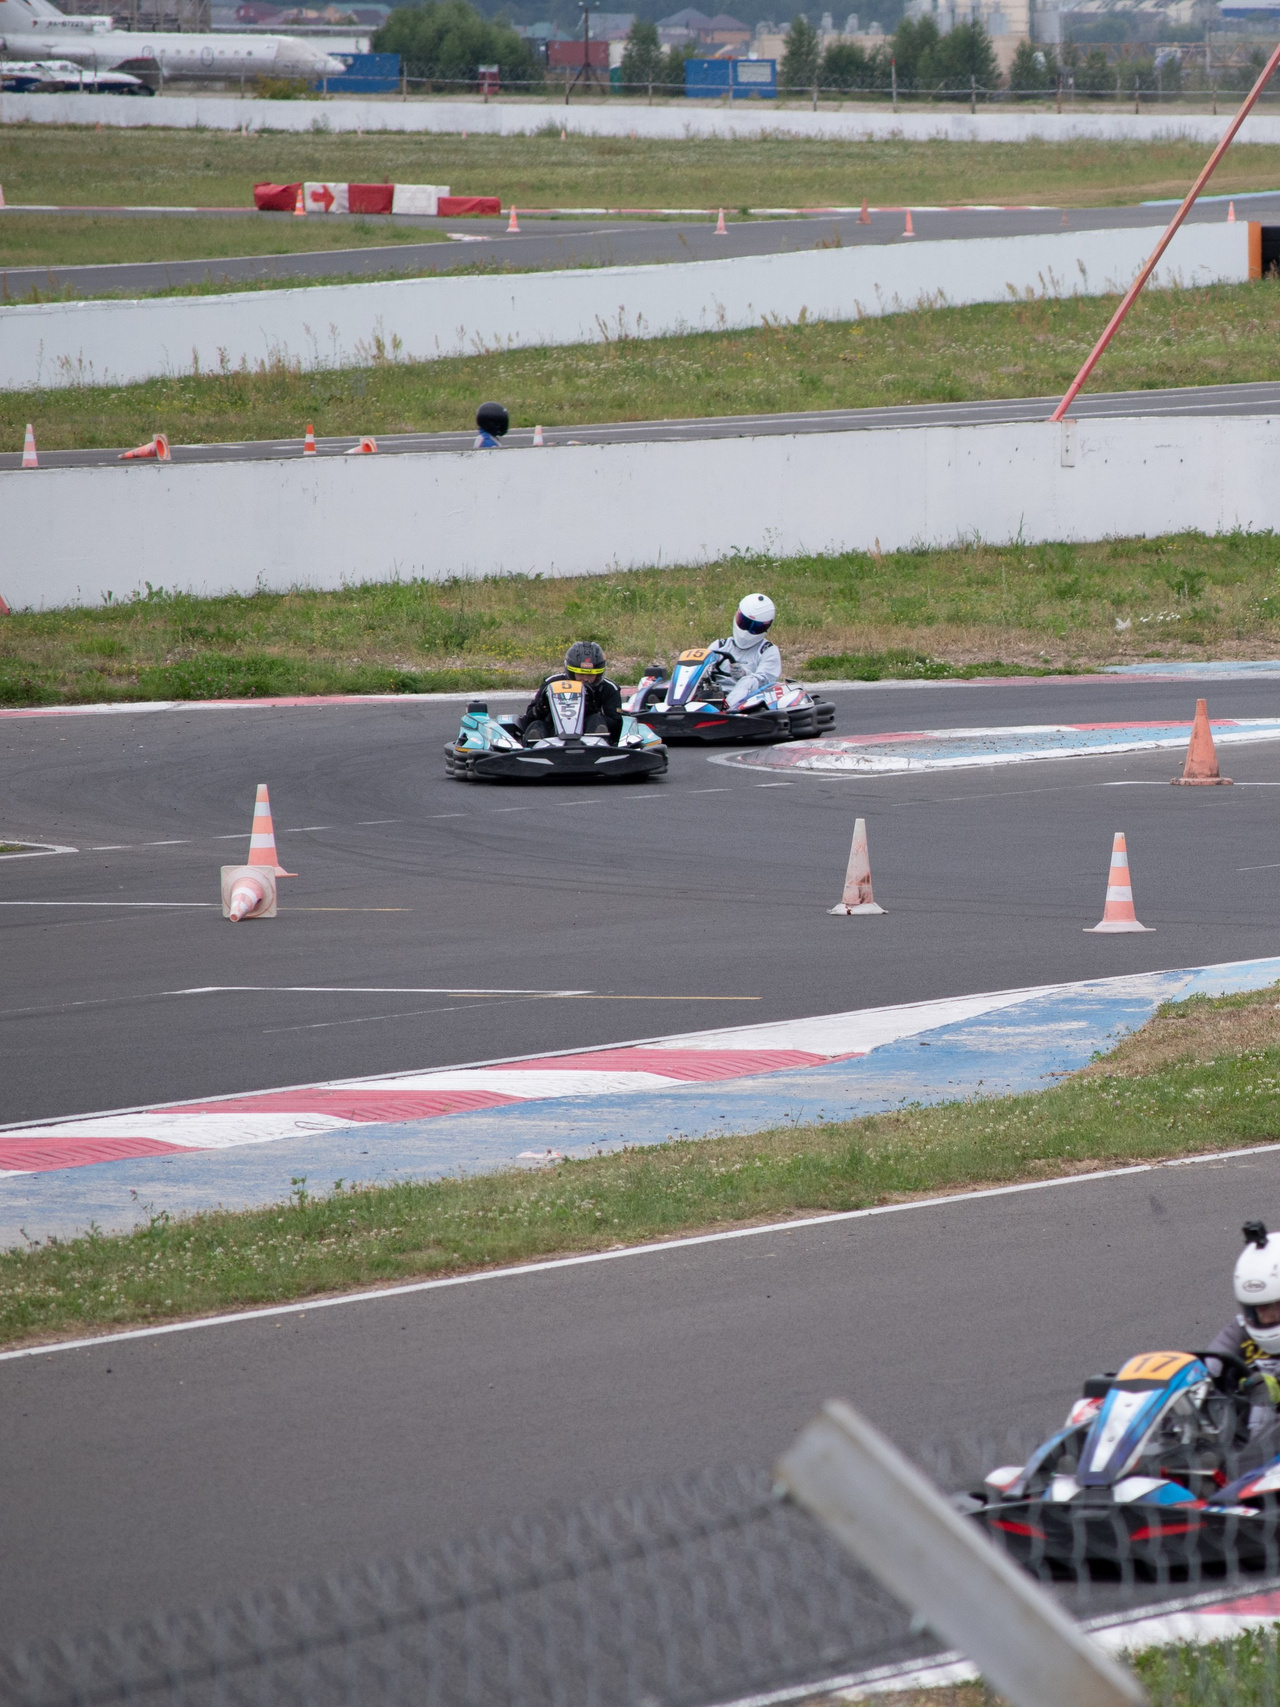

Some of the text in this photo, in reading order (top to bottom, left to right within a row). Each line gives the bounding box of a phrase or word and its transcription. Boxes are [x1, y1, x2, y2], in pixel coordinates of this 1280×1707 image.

[686, 650, 706, 658] 15
[560, 705, 577, 718] 5
[1133, 1354, 1182, 1374] 17
